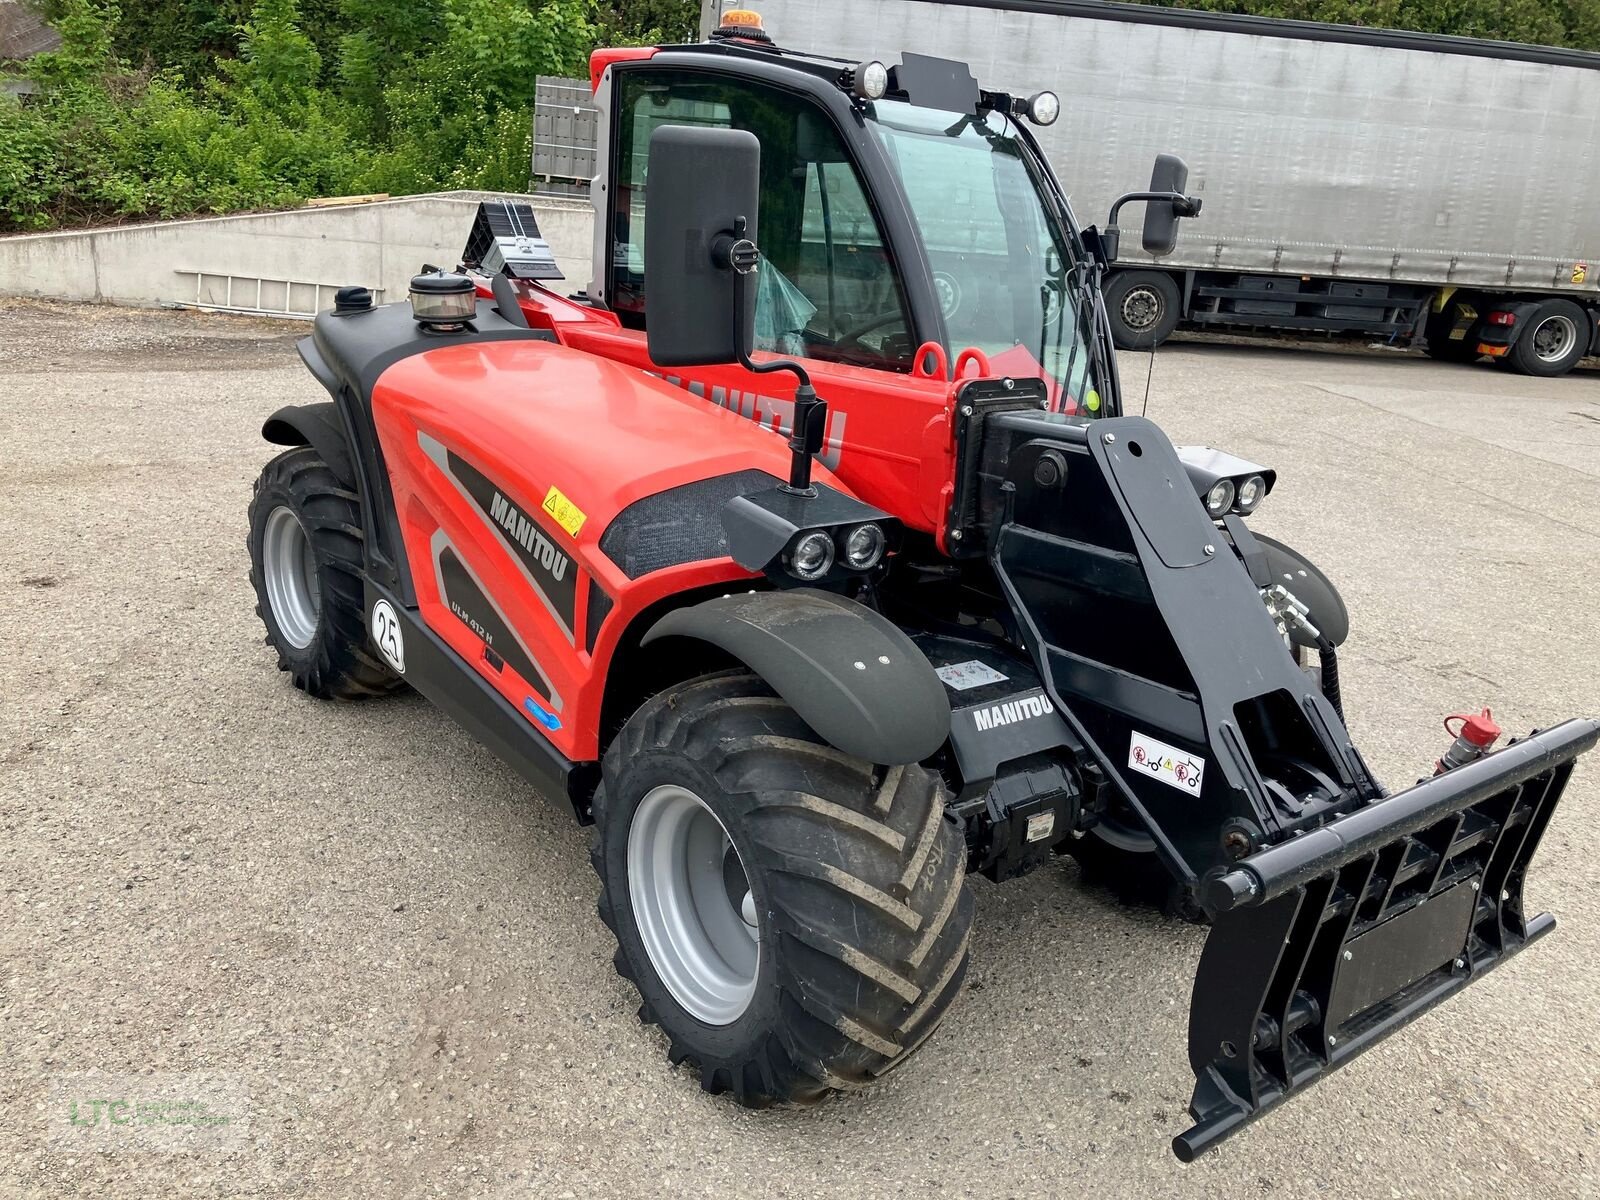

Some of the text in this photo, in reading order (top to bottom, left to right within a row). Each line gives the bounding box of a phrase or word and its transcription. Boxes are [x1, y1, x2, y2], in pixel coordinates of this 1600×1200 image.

[490, 491, 568, 581] MANITOU
[378, 611, 399, 663] 25
[451, 601, 493, 644] ULM 412 H
[973, 694, 1054, 731] MANITOU
